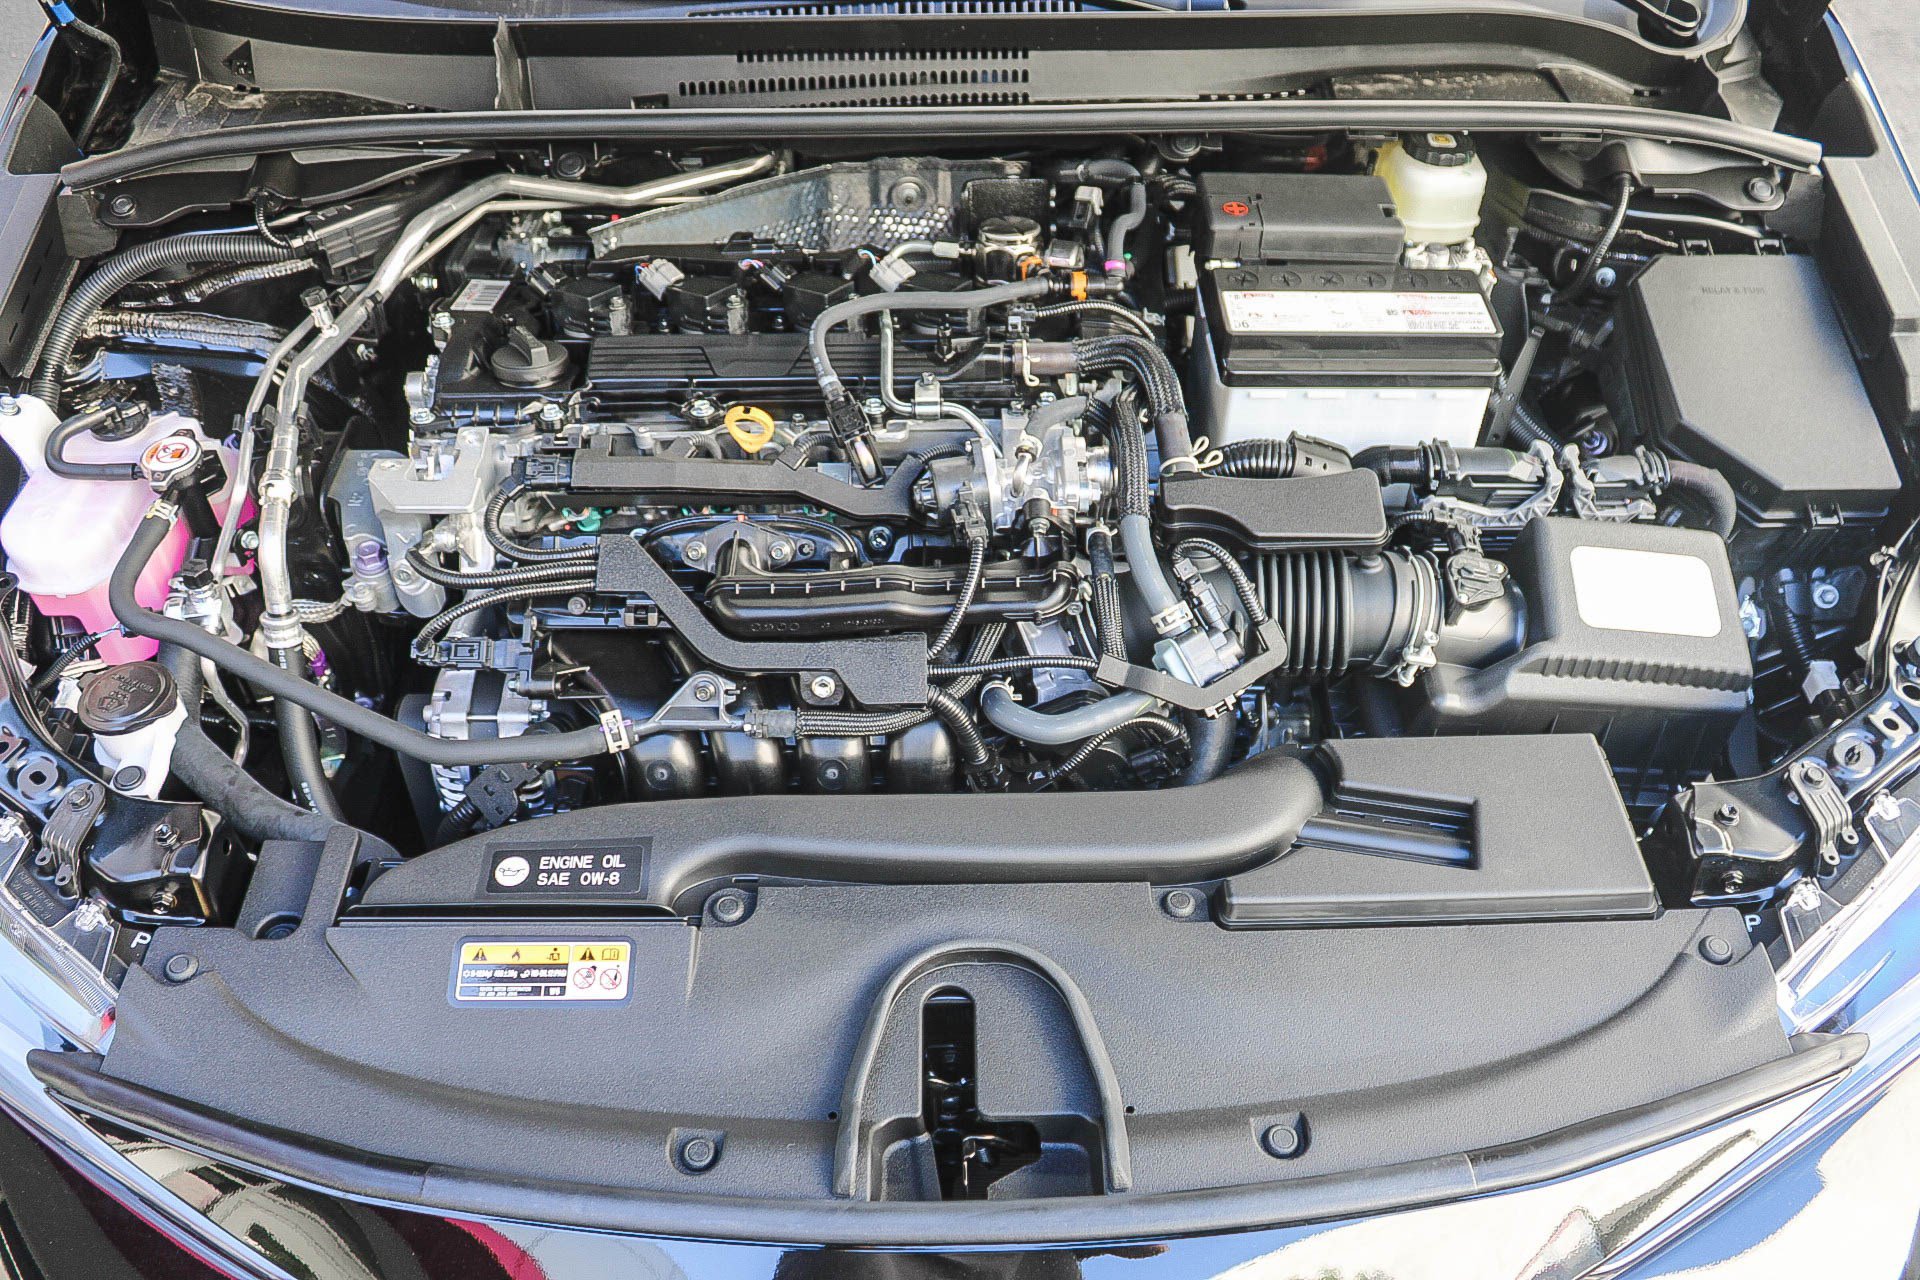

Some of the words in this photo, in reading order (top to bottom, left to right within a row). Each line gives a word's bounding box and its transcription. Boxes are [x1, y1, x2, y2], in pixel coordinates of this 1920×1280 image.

[538, 855, 594, 870] ENGINE
[602, 854, 626, 868] OIL
[536, 872, 570, 886] SAE
[580, 871, 620, 886] 0W-8
[1744, 914, 1762, 933] P
[130, 931, 152, 949] P
